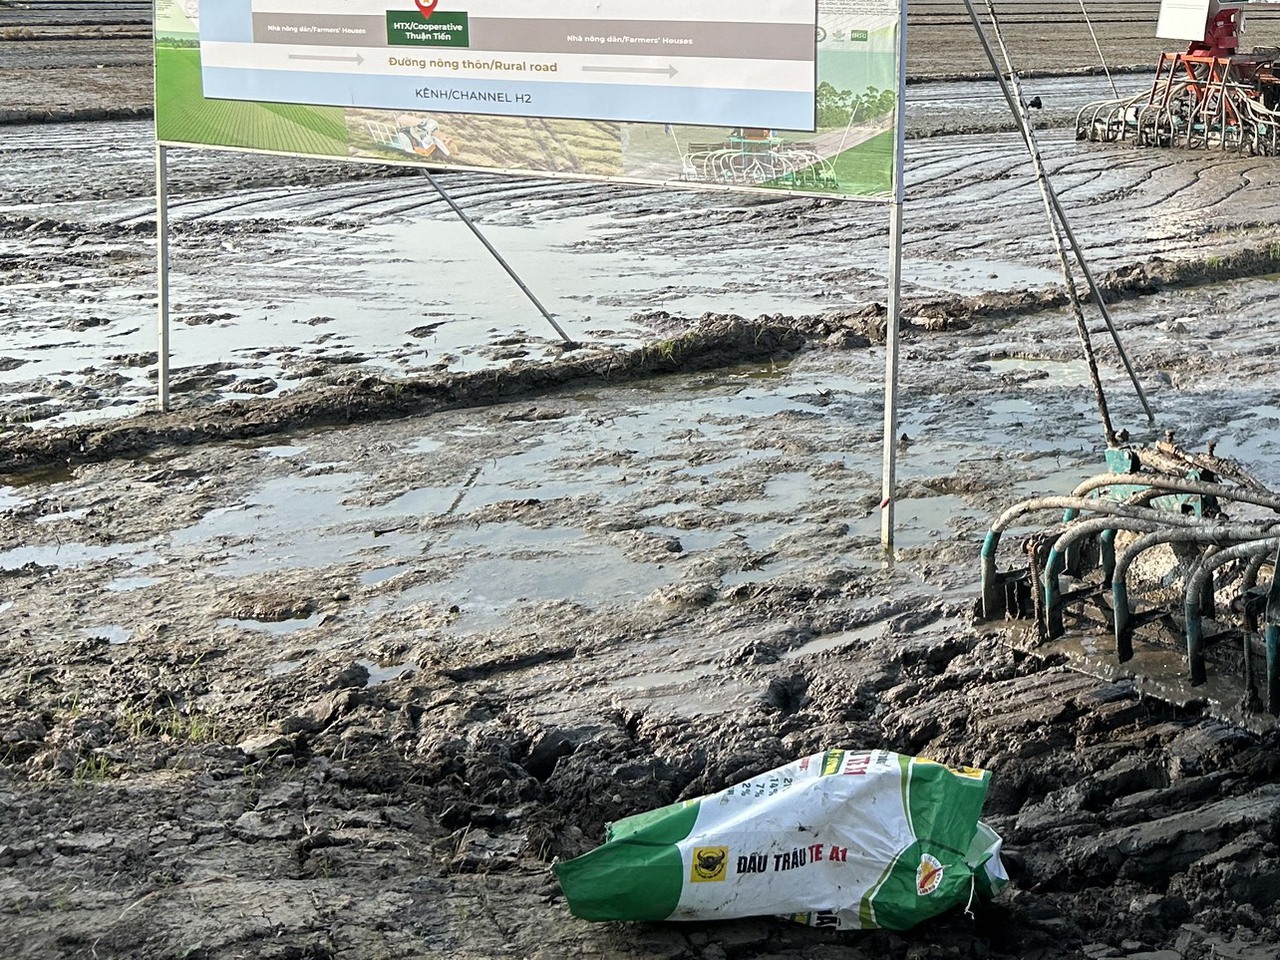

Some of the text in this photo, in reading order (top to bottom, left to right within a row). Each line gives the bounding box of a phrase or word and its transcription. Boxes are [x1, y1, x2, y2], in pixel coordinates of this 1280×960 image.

[394, 22, 463, 31] HTX/Cooperative
[406, 32, 451, 41] Thuận Tiến
[389, 57, 557, 72] Đường nông thôn/Rural road
[415, 87, 532, 104] KÊNH/CHANNEL H2
[741, 782, 751, 796] 2%
[755, 783, 765, 797] 7%
[774, 850, 807, 871] TRÂU
[808, 844, 824, 863] TE
[829, 845, 848, 862] A1
